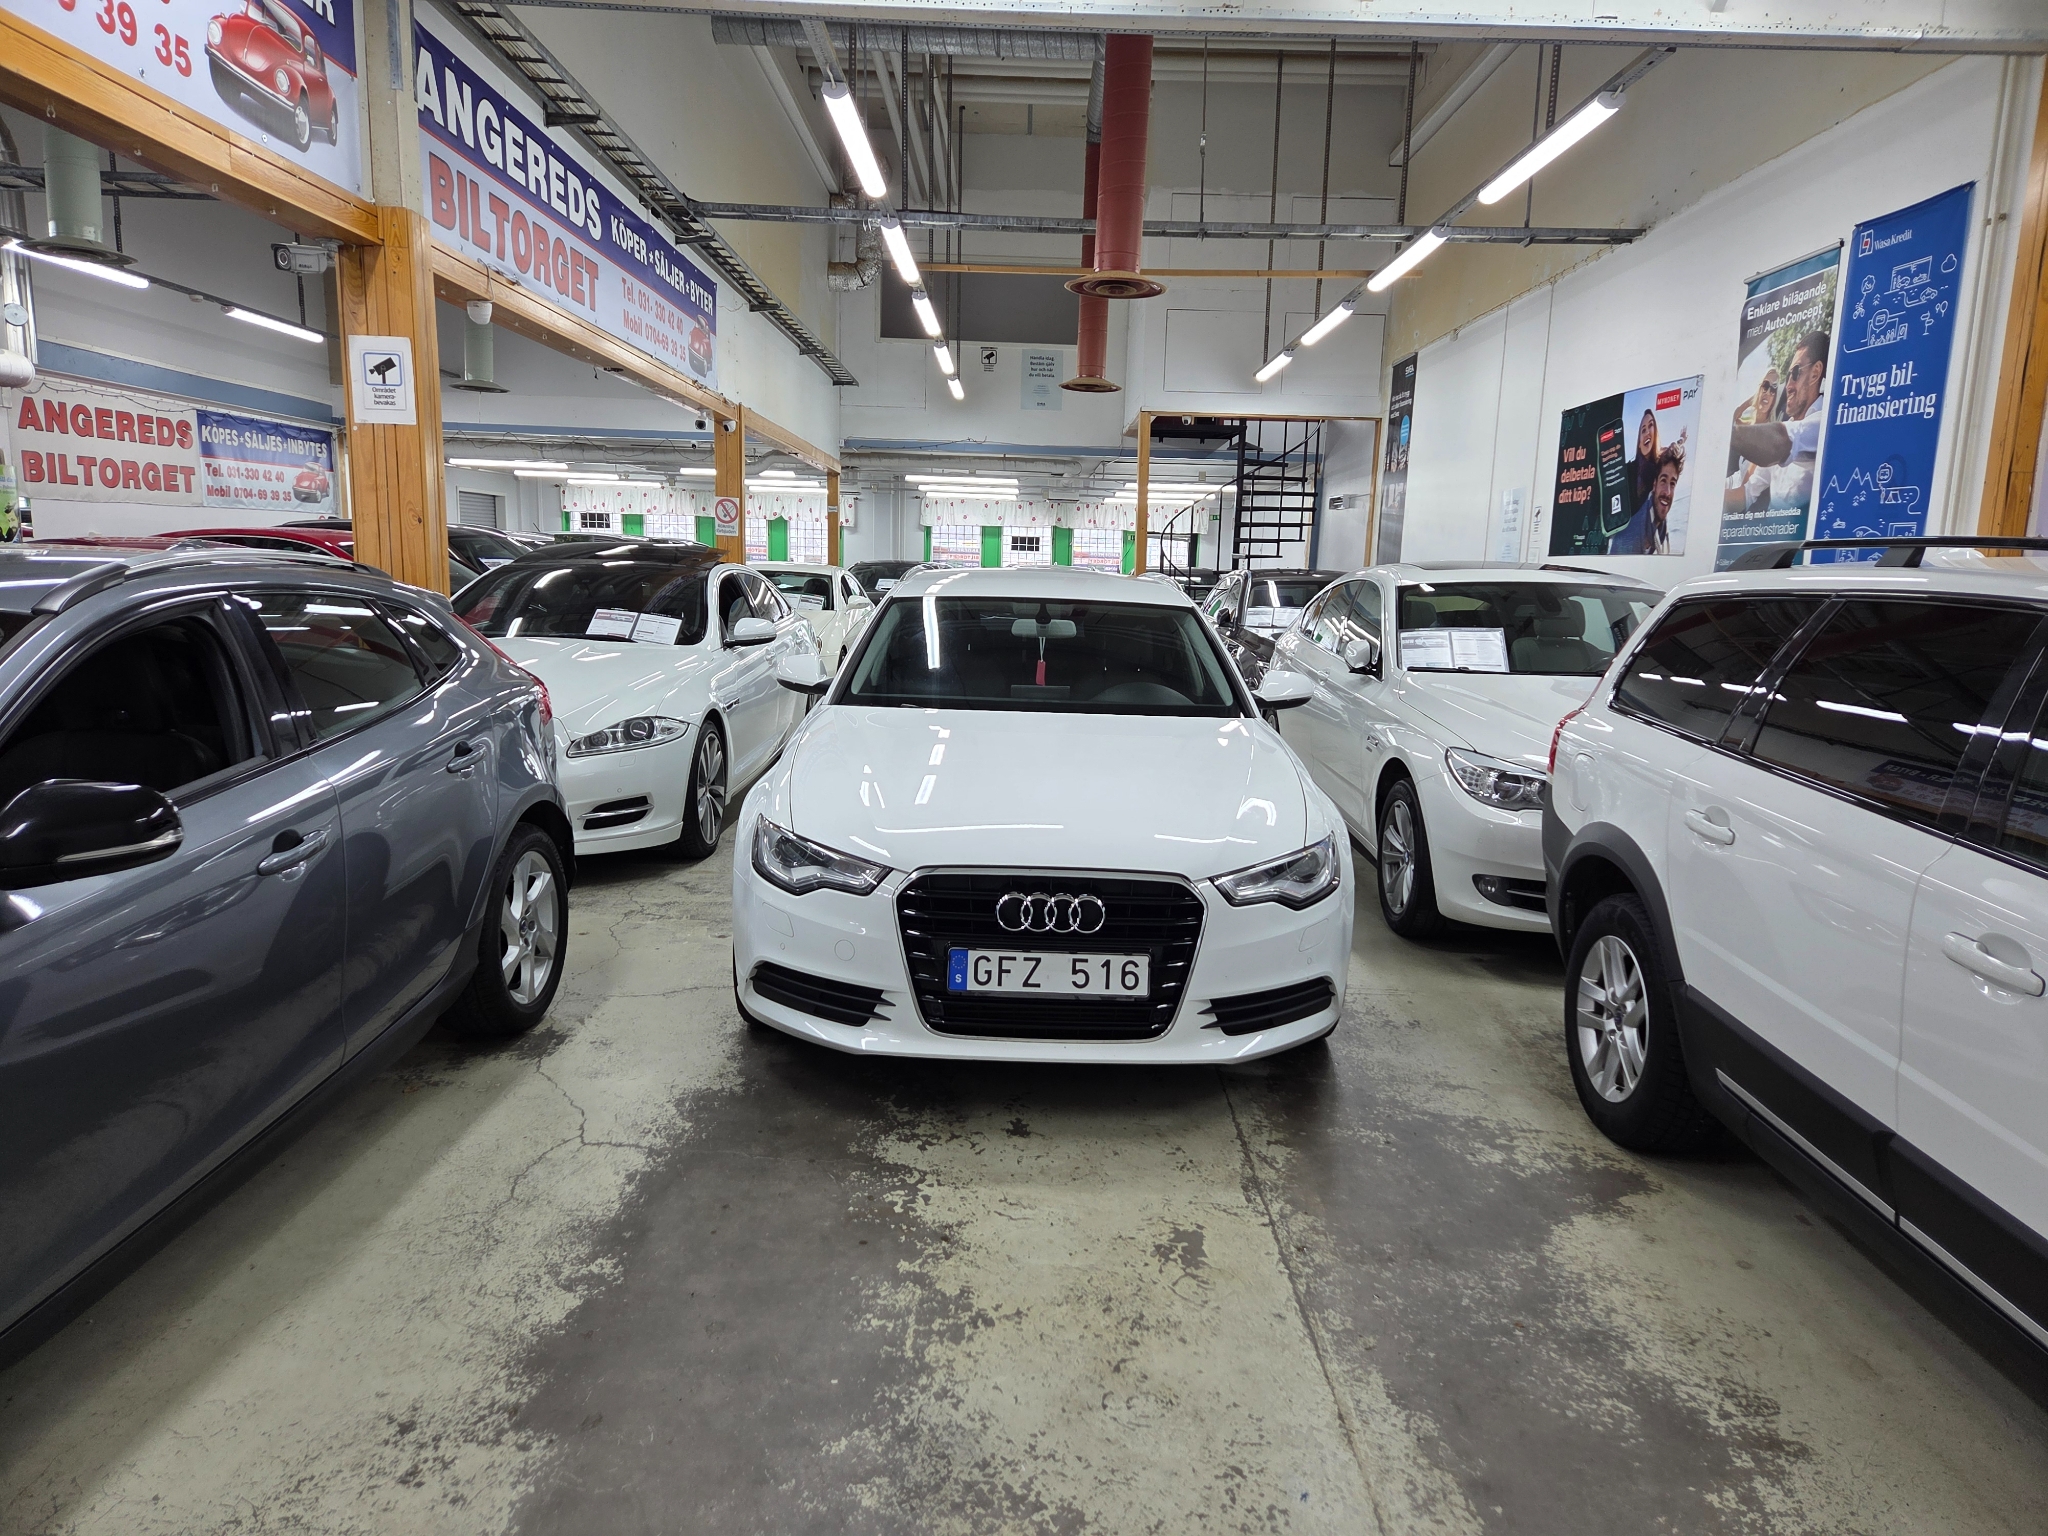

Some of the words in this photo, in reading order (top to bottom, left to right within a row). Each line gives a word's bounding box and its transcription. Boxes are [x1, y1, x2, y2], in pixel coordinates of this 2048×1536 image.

[96, 0, 137, 47] 39
[154, 23, 192, 77] 35
[417, 46, 601, 241] ANGEREDS
[429, 151, 599, 312] BILTORGET
[1874, 238, 1891, 250] Wasa
[1891, 229, 1913, 245] Kredit
[610, 214, 648, 266] KÖPER
[654, 249, 685, 295] SÄLJER
[690, 279, 713, 316] BYTER
[621, 277, 635, 305] Tel.
[668, 310, 675, 330] 42
[677, 316, 684, 336] 40
[1747, 300, 1780, 320] Enklare
[1782, 281, 1827, 308] bilägande
[623, 309, 643, 337] Mobil
[671, 338, 678, 358] 39
[680, 344, 687, 363] 35
[1746, 322, 1764, 339] med
[1764, 301, 1823, 333] AutoConcept
[1683, 388, 1698, 401] PAY
[1841, 370, 1888, 399] Trygg
[1890, 360, 1918, 389] bil-
[17, 396, 193, 449] ANGEREDS
[1834, 391, 1937, 426] finansiering
[201, 423, 239, 447] KÖPES
[244, 430, 283, 453] SÄLJES
[287, 437, 327, 458] INBYTES
[1563, 446, 1576, 463] Vill
[1576, 445, 1587, 461] du
[21, 450, 195, 493] BILTORGET
[205, 463, 224, 478] Tel.
[262, 469, 273, 482] 42
[275, 471, 285, 483] 40
[1561, 465, 1596, 484] delbetala
[206, 484, 231, 498] Mobil
[270, 490, 280, 501] 39
[283, 491, 292, 502] 35
[1558, 489, 1573, 504] ditt
[1573, 485, 1592, 505] köp?
[1720, 521, 1800, 540] reparationskostnader
[1745, 511, 1753, 520] dig
[1754, 510, 1765, 519] mot
[1765, 507, 1802, 517] oförutsedda
[955, 973, 962, 983] S
[973, 955, 1042, 988] GFZ
[1071, 958, 1140, 991] 516
